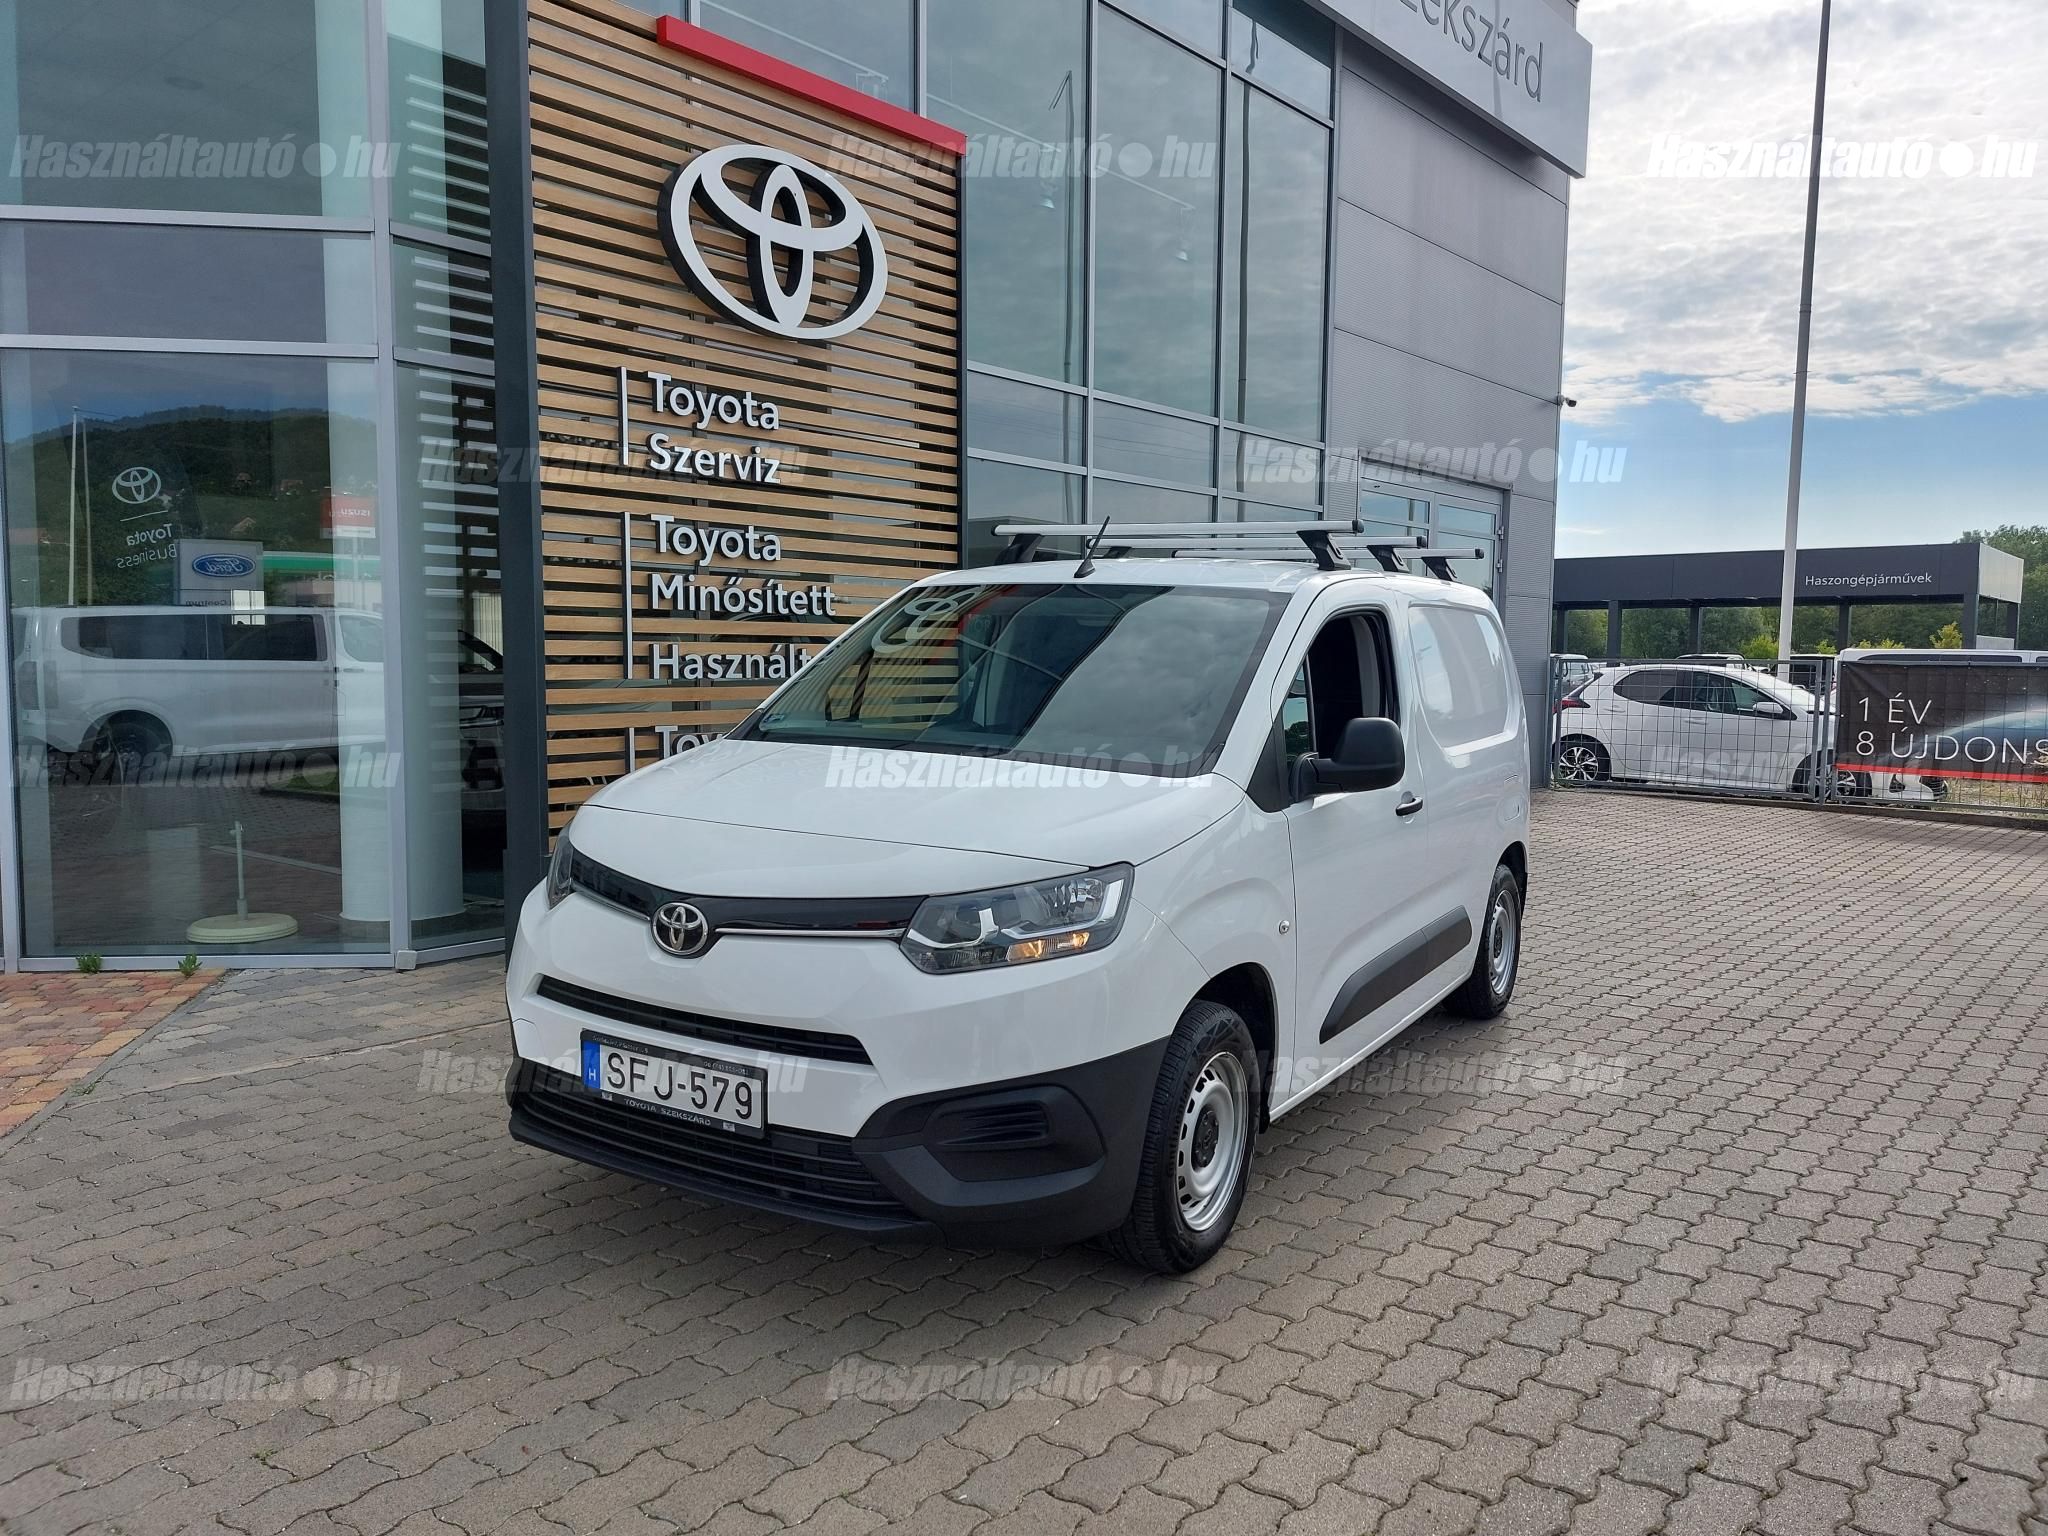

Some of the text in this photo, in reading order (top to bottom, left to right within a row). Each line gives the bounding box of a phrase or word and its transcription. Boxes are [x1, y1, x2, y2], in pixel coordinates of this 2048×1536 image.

[1398, 0, 1543, 102] ekszárd
[647, 371, 780, 430] Toyota
[647, 433, 781, 484] Szerviz
[650, 514, 782, 566] Toyota
[651, 573, 837, 616] Minősített
[1805, 572, 1932, 587] Haszongépjárművek
[1859, 692, 1932, 724] 1 ÉV
[1856, 730, 1874, 756] 8
[588, 1052, 753, 1120] H SFJ-579
[624, 1098, 657, 1113] TOYOTA
